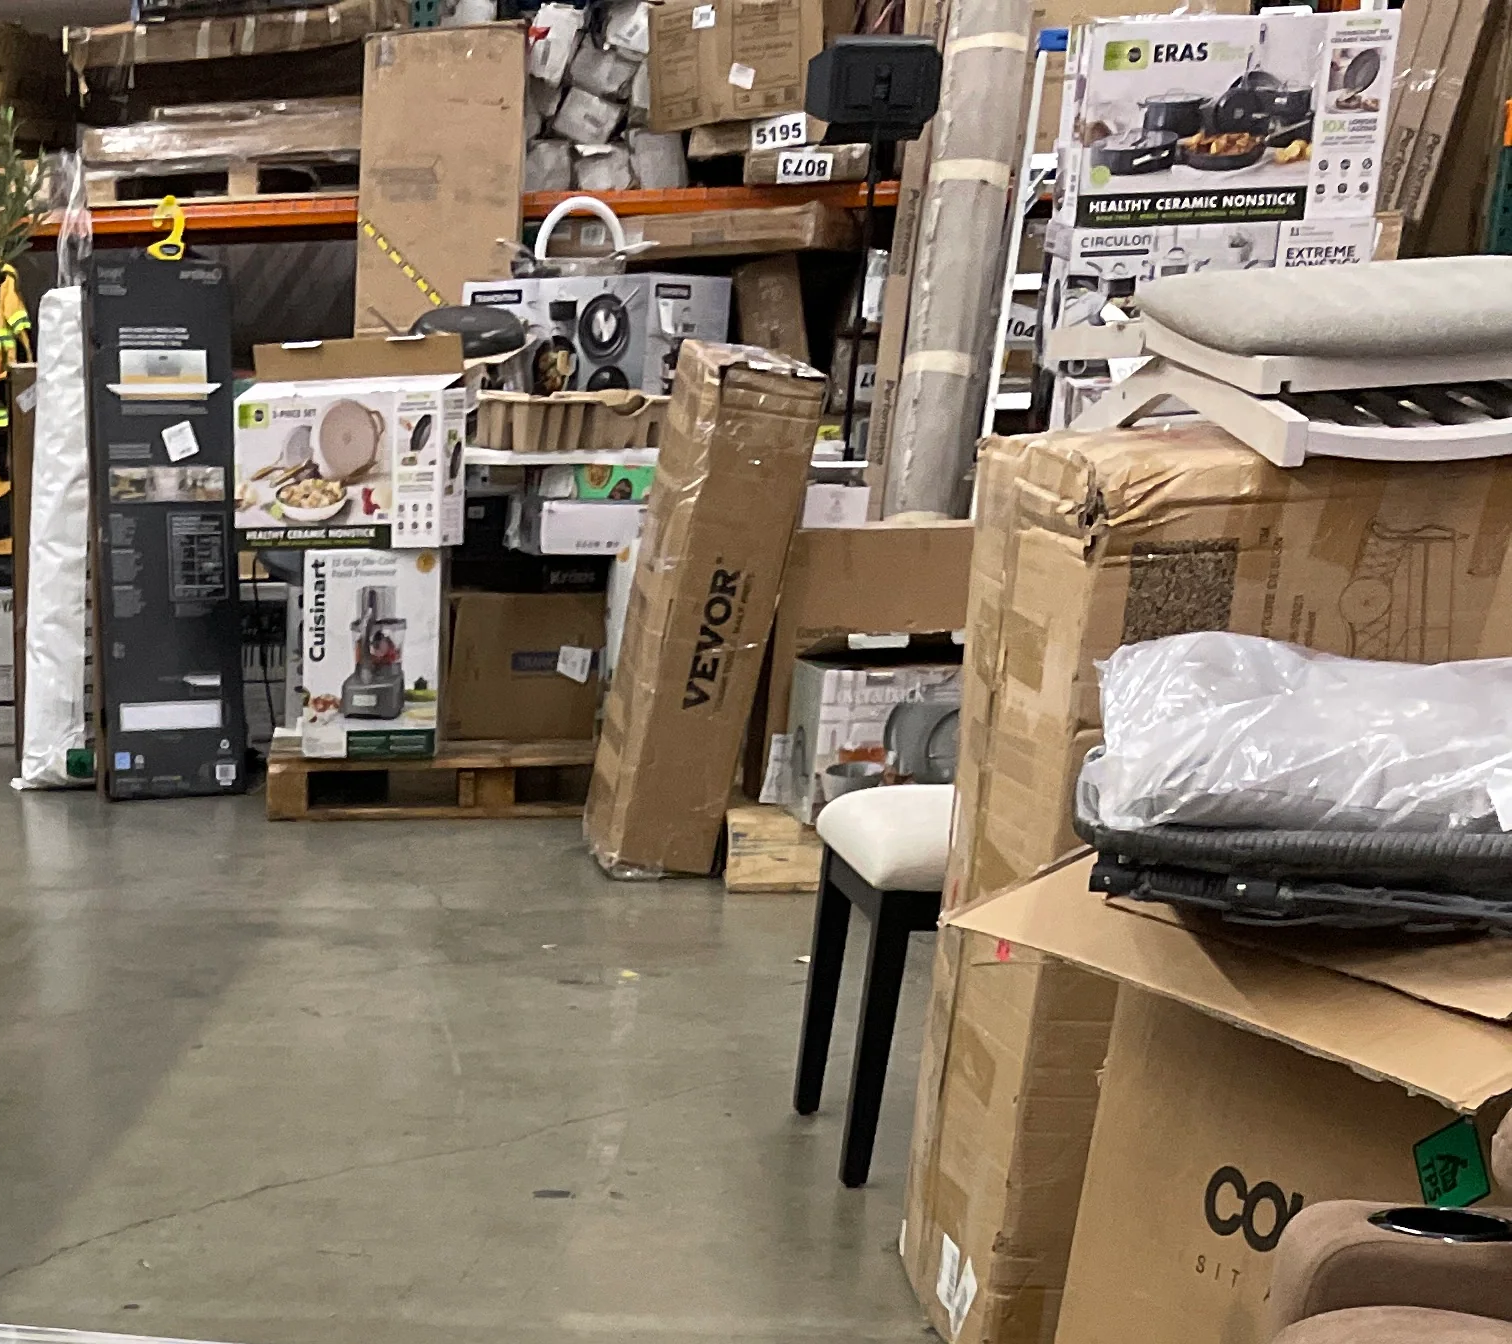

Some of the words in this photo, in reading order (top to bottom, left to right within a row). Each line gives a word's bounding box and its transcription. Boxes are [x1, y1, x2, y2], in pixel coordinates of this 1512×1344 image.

[1153, 43, 1208, 63] ERAS
[756, 122, 803, 145] 5195
[782, 158, 828, 177] 8073
[1089, 199, 1151, 214] HEALTHY
[1155, 196, 1218, 211] CERAMIC
[1222, 192, 1296, 209] NONSTICK
[1081, 235, 1154, 248] CIRCULON
[1286, 245, 1357, 260] EXTREME
[1006, 318, 1036, 338] 104
[309, 558, 327, 662] Cuisinart
[682, 568, 742, 711] VEVOR
[1204, 1165, 1305, 1252] CO
